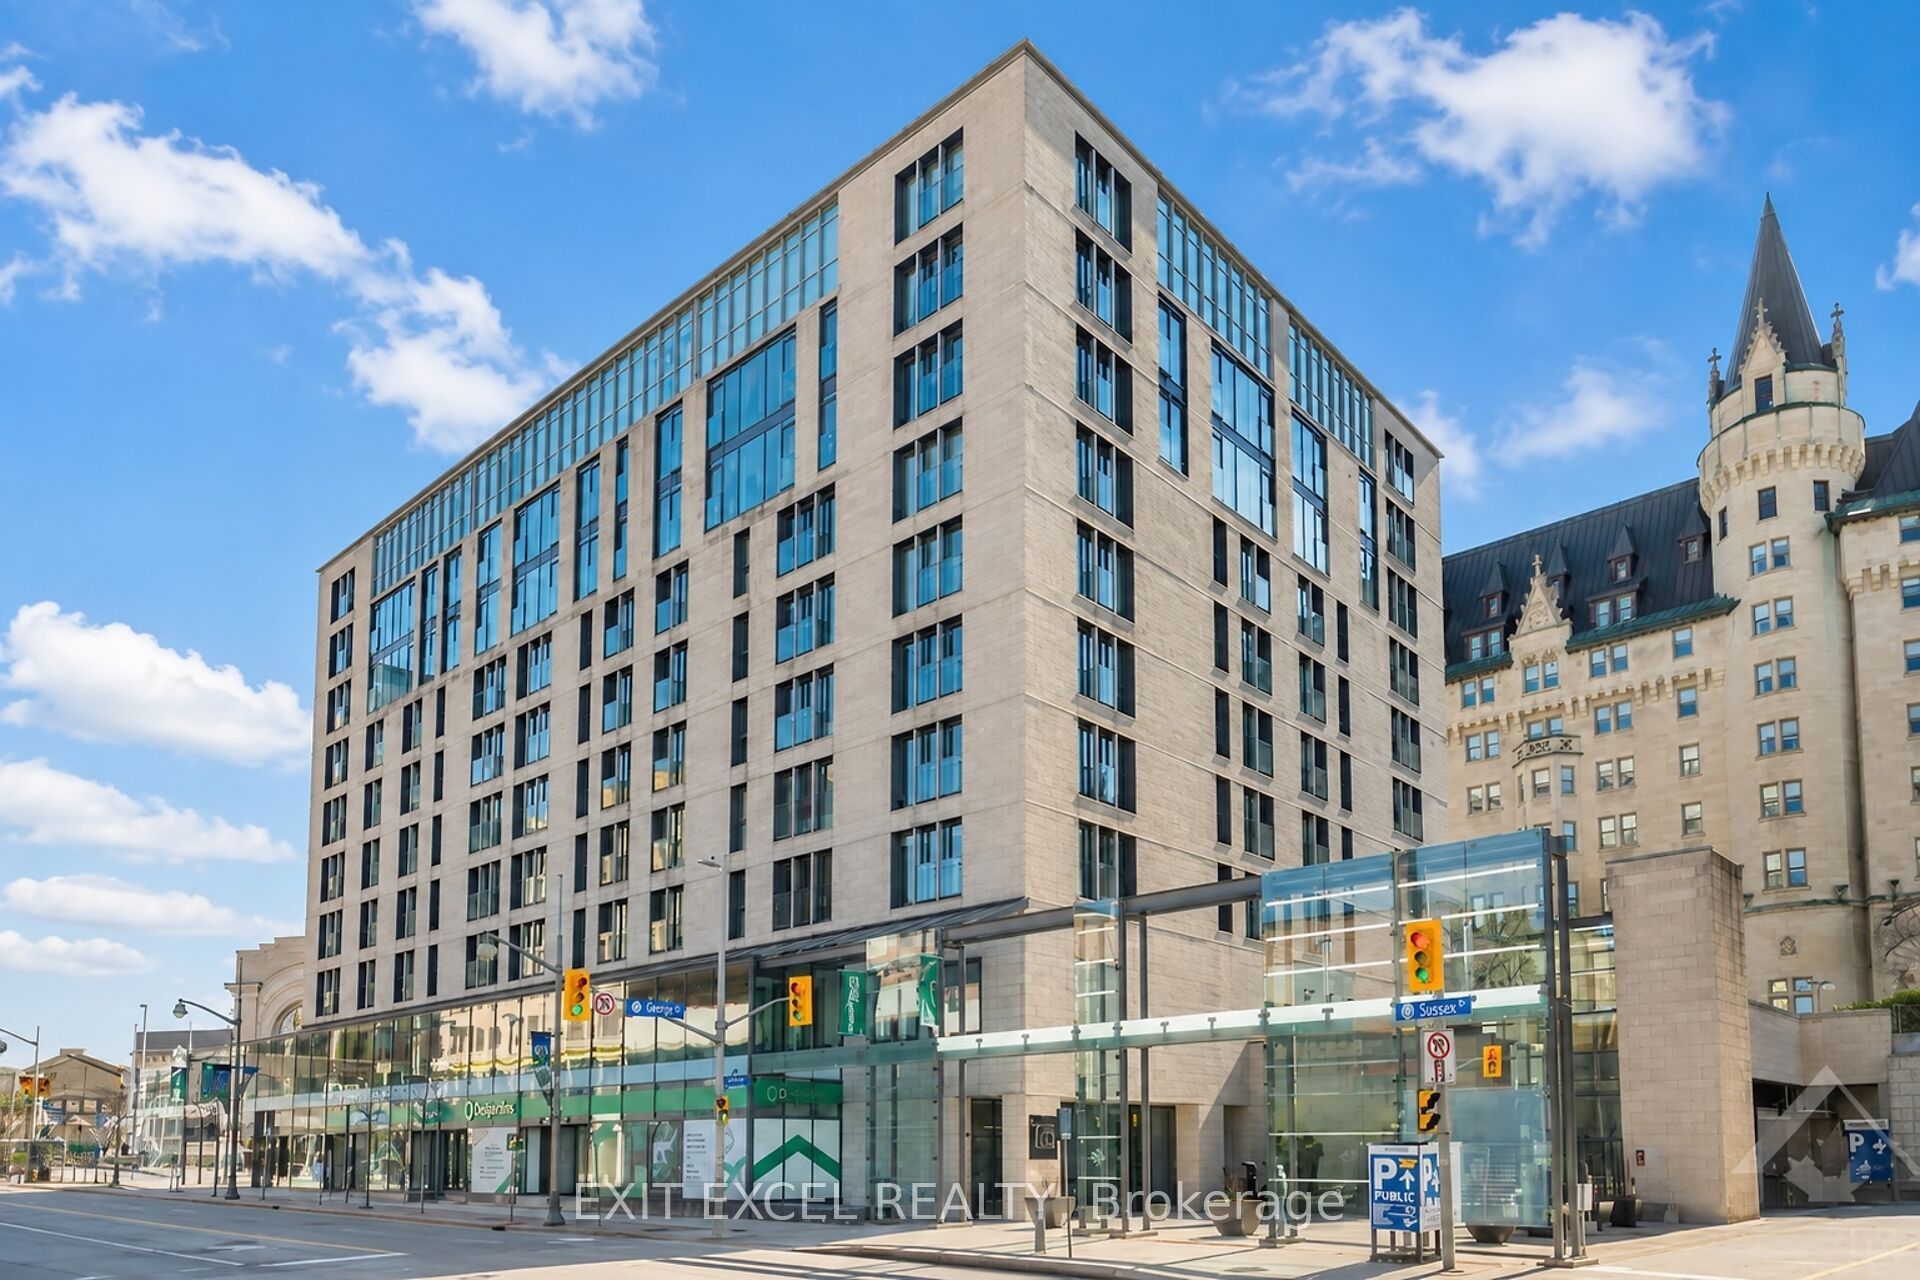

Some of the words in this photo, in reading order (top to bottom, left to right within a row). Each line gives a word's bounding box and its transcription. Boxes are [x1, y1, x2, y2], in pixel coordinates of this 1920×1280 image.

[1419, 1003, 1457, 1017] Sussex
[1849, 1133, 1864, 1152] P
[1374, 1158, 1398, 1190] P
[1374, 1191, 1415, 1203] PUBLIC
